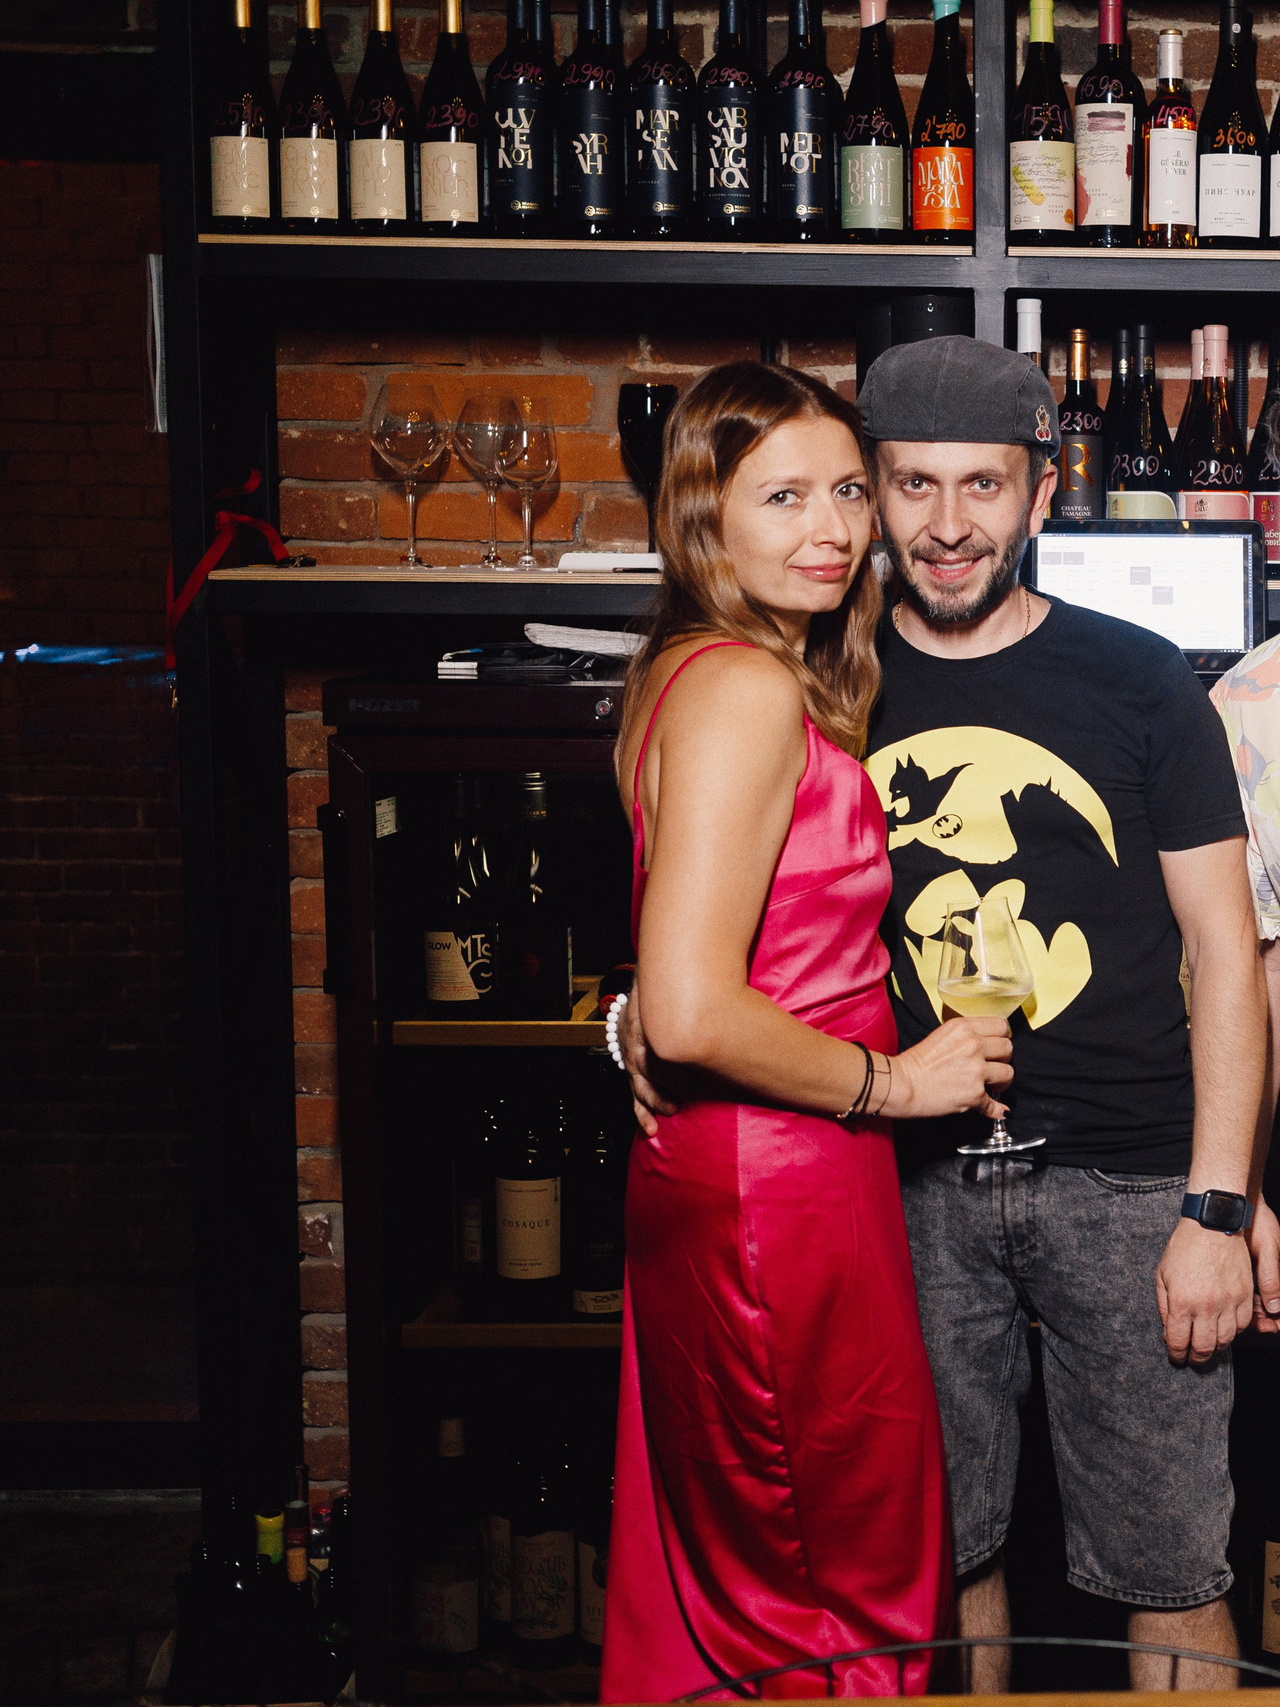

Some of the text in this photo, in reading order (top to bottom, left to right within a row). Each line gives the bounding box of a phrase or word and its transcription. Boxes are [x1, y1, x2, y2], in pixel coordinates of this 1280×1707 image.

[565, 63, 616, 85] 2990
[1213, 127, 1256, 148] 3600
[1234, 188, 1256, 197] НУАР
[1060, 411, 1102, 431] 2300
[1060, 443, 1096, 492] R
[1110, 453, 1160, 478] 2300
[1193, 459, 1244, 486] 2200
[502, 1219, 550, 1230] COSAQUE
